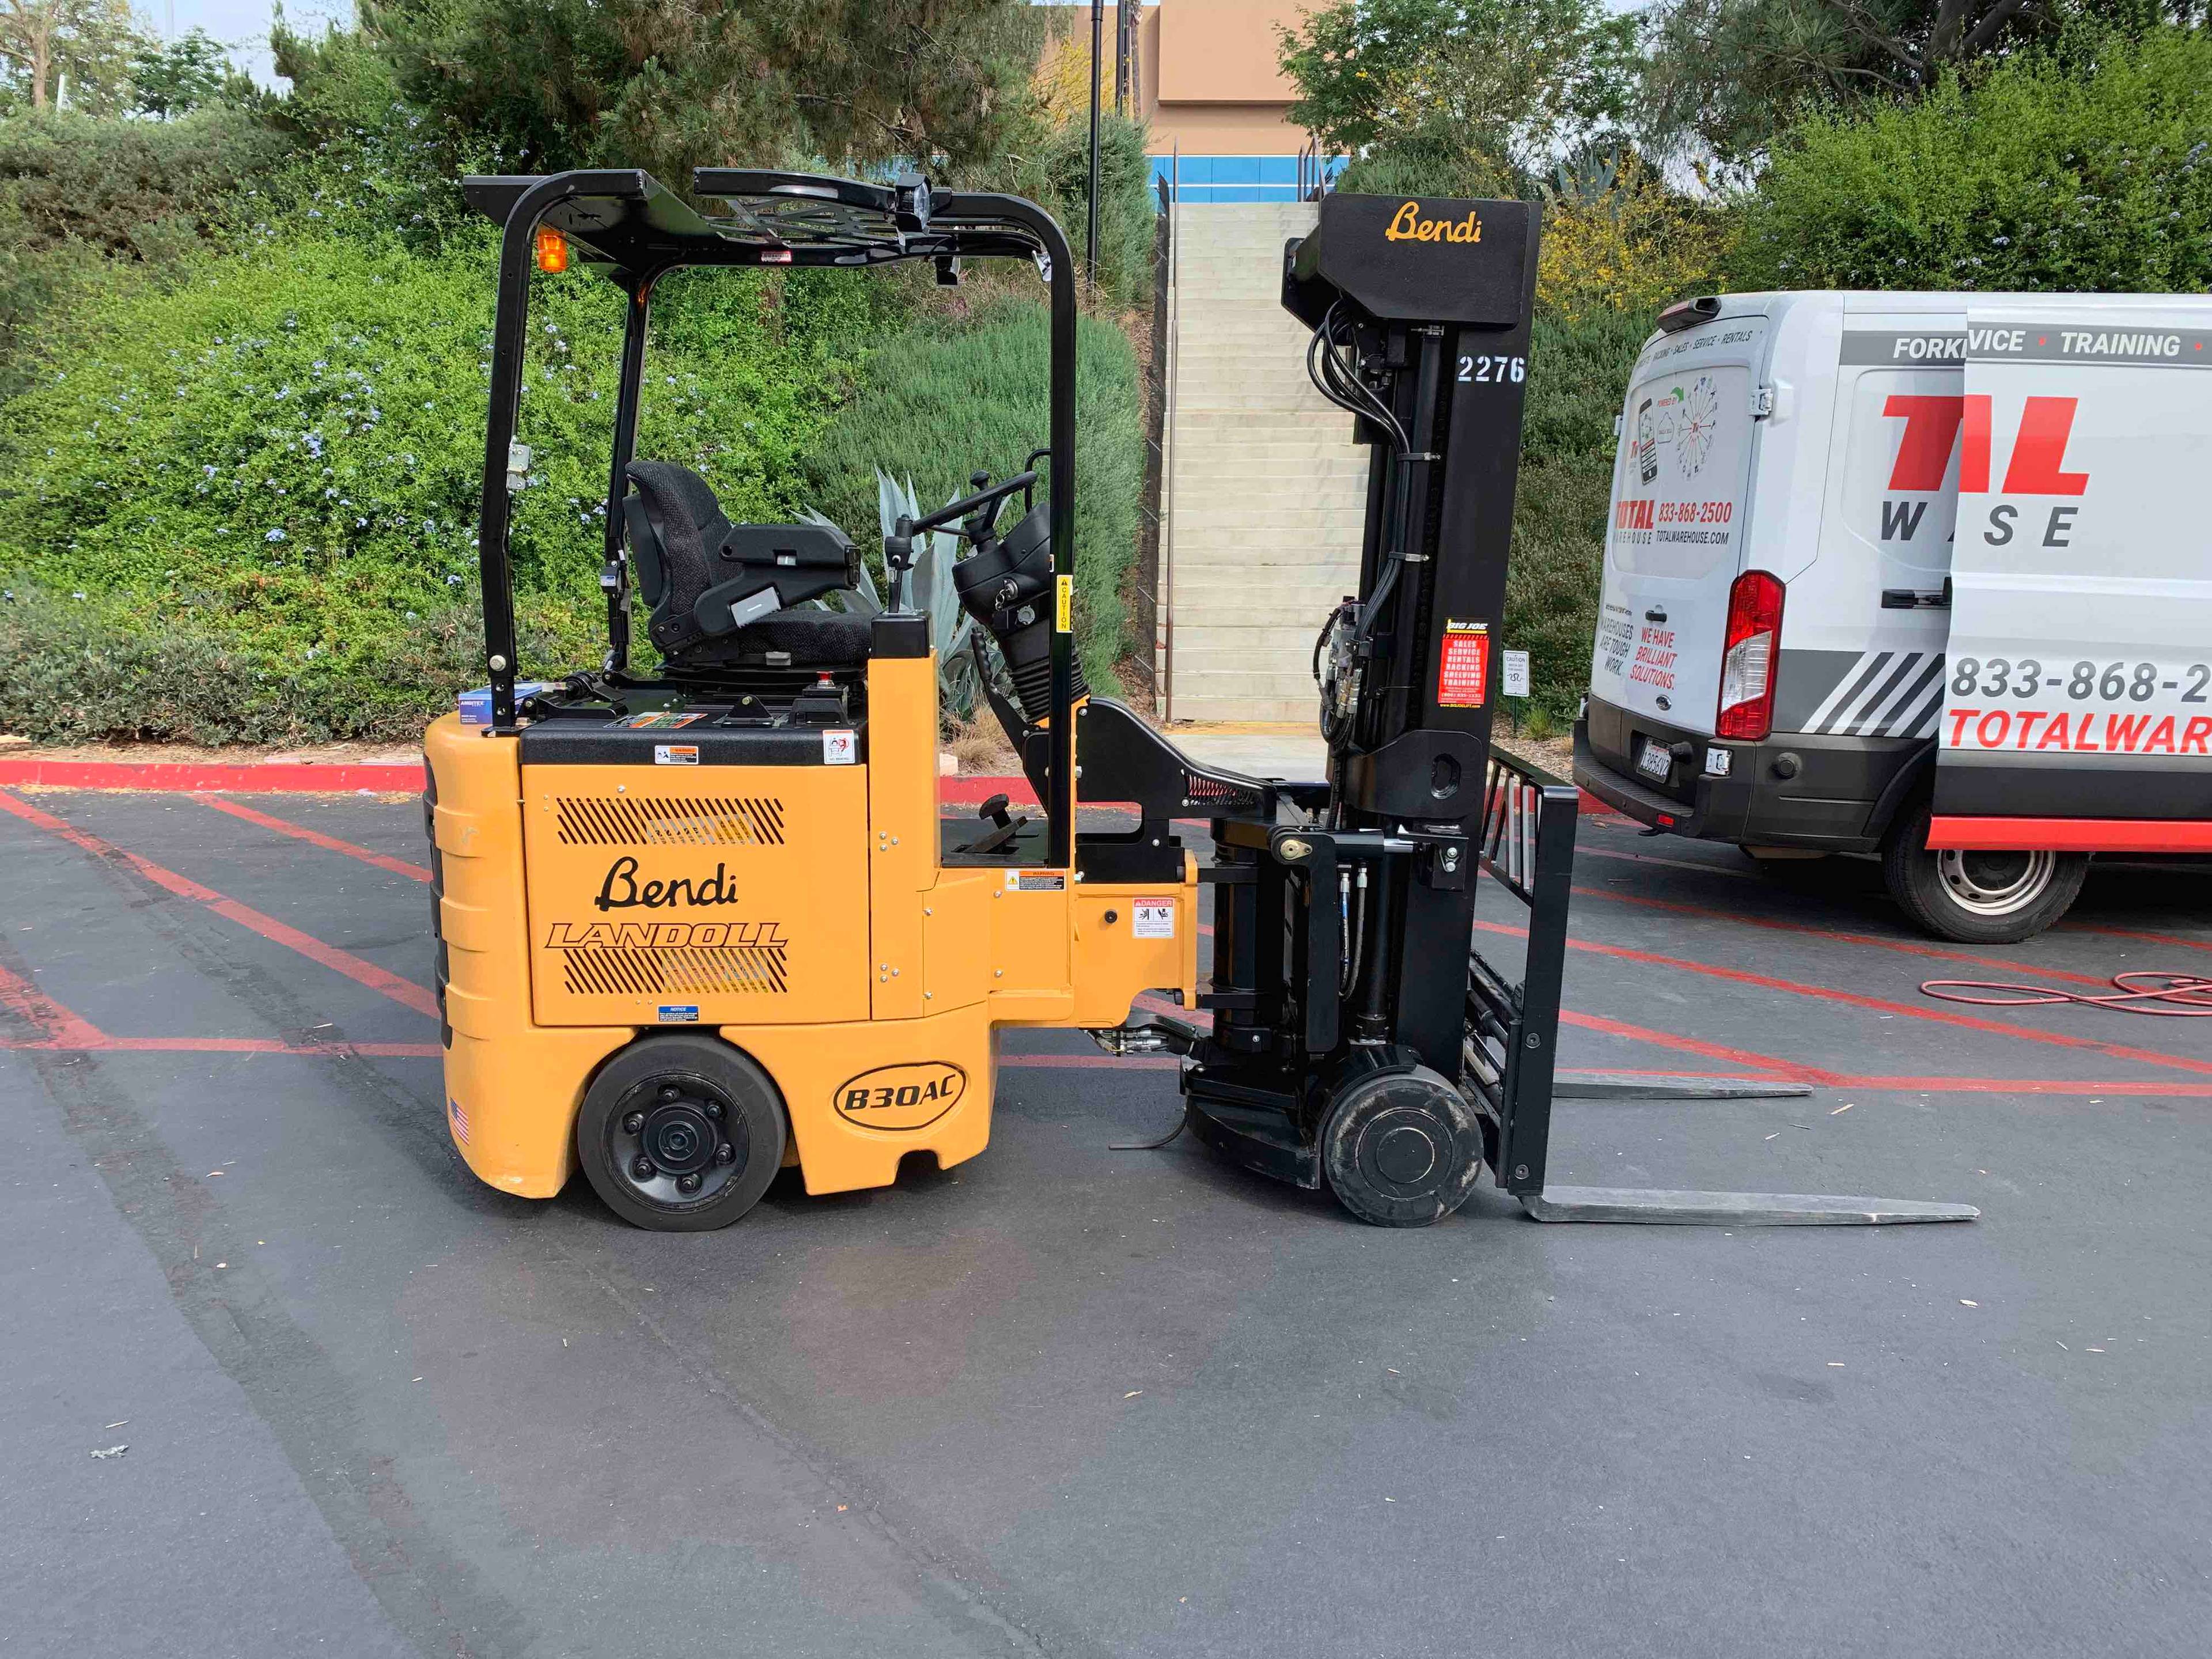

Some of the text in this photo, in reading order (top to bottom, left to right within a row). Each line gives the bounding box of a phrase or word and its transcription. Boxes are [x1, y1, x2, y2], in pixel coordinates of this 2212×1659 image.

[1385, 201, 1482, 243] Bendi
[1692, 335, 1717, 350] SERVICE
[1721, 330, 1753, 345] RENTALS
[2061, 332, 2181, 356] TRAINING
[1458, 357, 1524, 382] 2276
[1659, 502, 1732, 524] 833-868-2500
[1656, 531, 1729, 544] TOTALWAREHOUSE.COM
[1453, 640, 1476, 648] SALES
[1600, 635, 1631, 658] ARE TOUGH
[1641, 627, 1675, 648] WE HAVE
[1447, 656, 1480, 664] RENTALS
[1448, 647, 1480, 656] SERVICE
[1635, 645, 1677, 669] BRILLIANT
[1446, 663, 1480, 671] RACKING
[1604, 656, 1623, 676] WORK.
[1630, 664, 1675, 690] SOLUTIONS.
[1444, 679, 1480, 687] TRAINING
[1951, 657, 2211, 703] 833-868-2
[1949, 709, 2212, 753] TOTALWAR
[594, 856, 738, 911] Bendi
[545, 923, 789, 948] LANDOLL
[844, 1074, 956, 1110] B30AC
